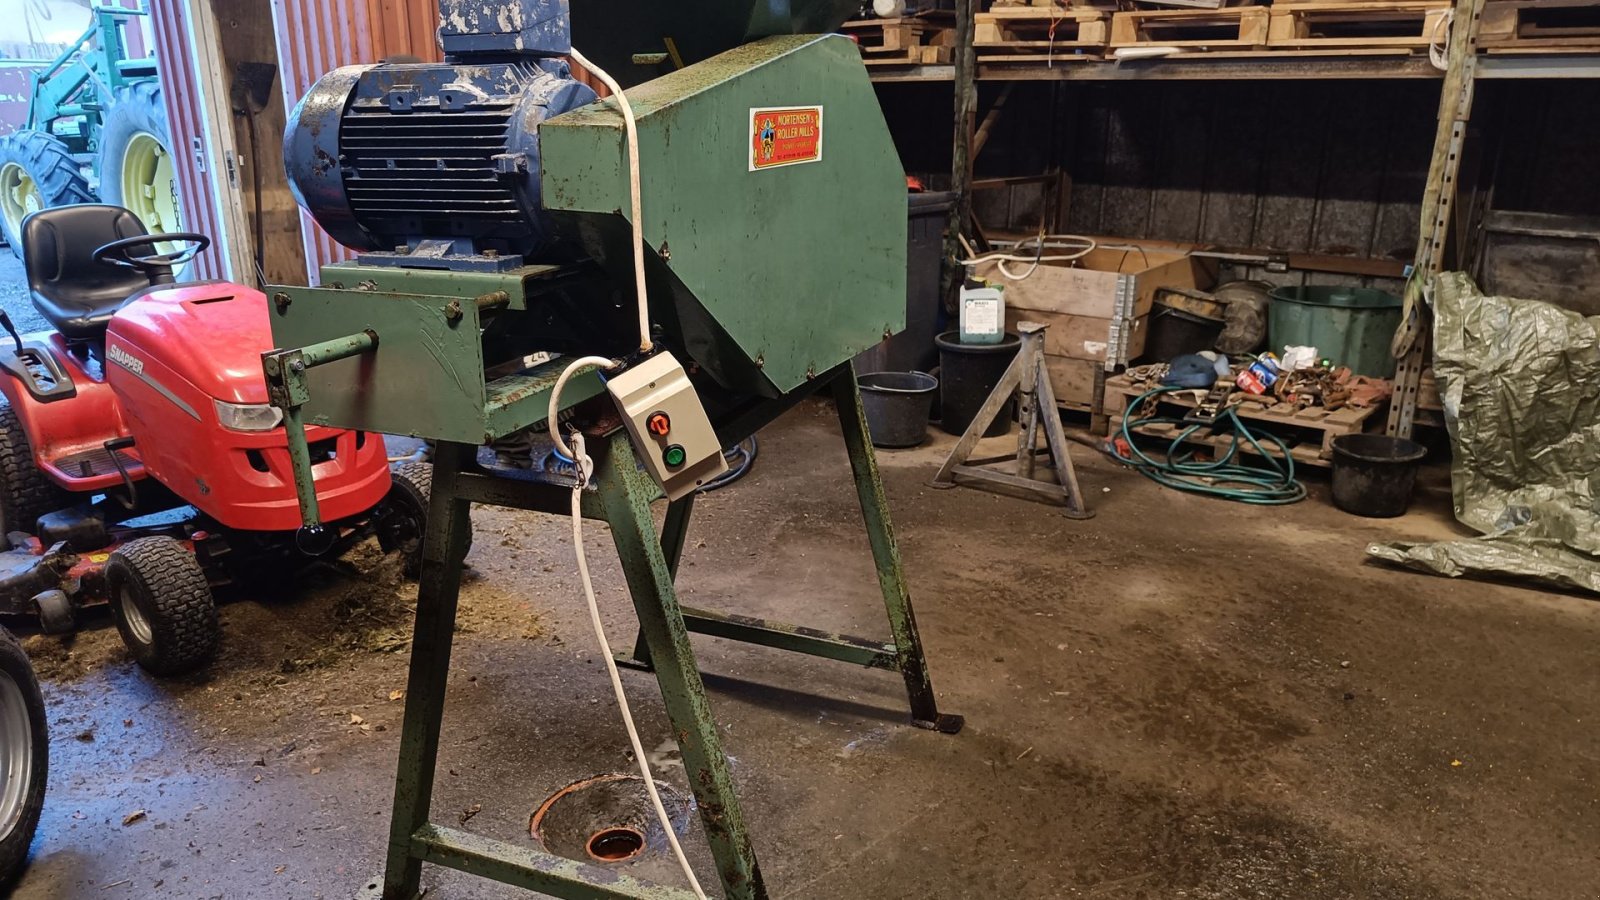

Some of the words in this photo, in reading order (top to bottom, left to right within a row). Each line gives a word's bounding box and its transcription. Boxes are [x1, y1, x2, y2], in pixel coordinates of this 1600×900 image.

[777, 127, 798, 139] ROLLER
[799, 126, 814, 138] MILLS
[110, 344, 144, 375] SNAPPER
